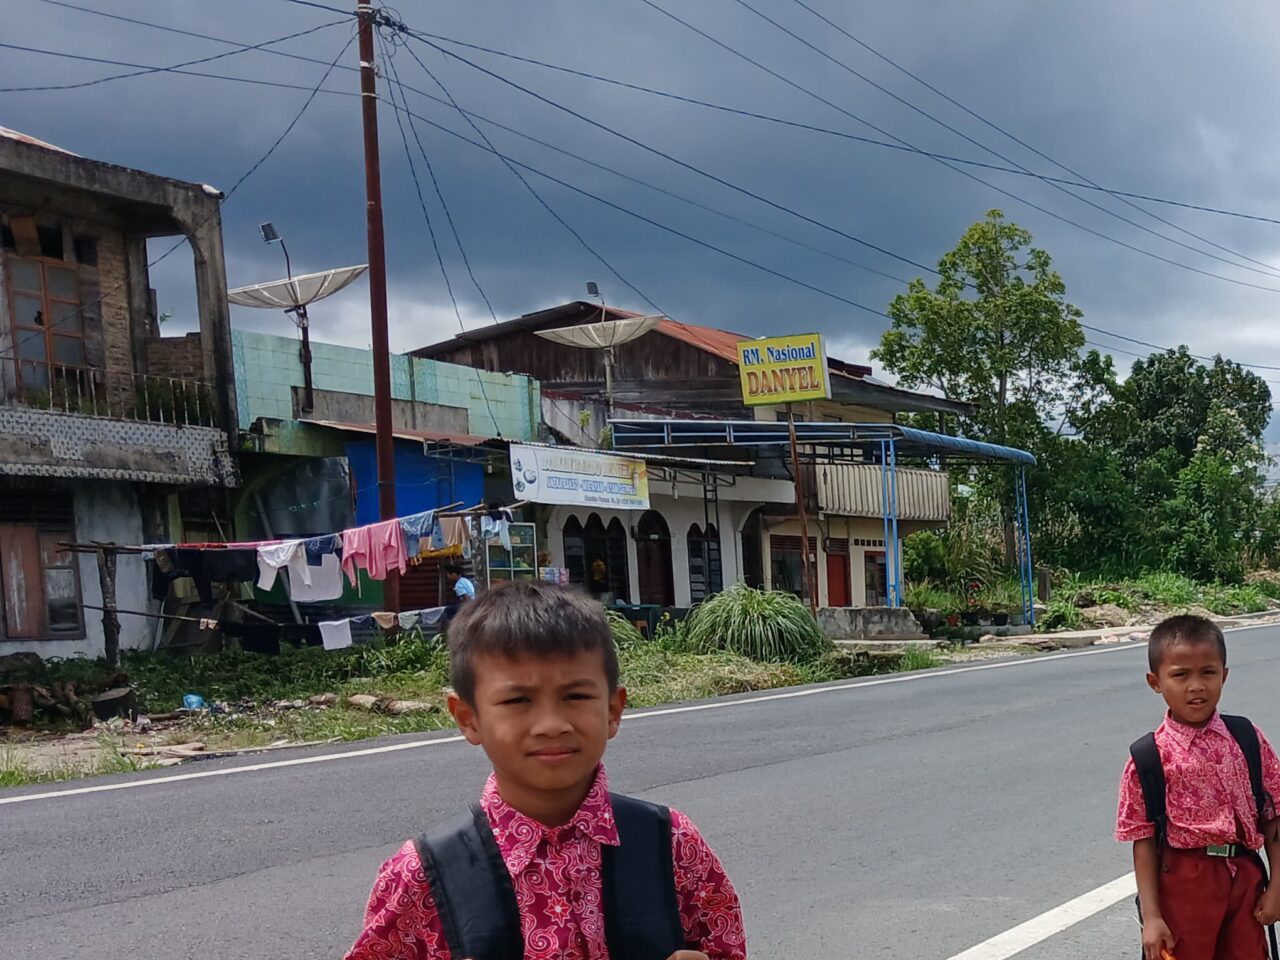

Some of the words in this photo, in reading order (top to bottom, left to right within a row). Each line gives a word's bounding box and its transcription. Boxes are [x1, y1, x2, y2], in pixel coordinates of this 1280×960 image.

[742, 348, 764, 366] RM.
[767, 342, 816, 362] Nasional
[746, 365, 820, 395] DANYEL
